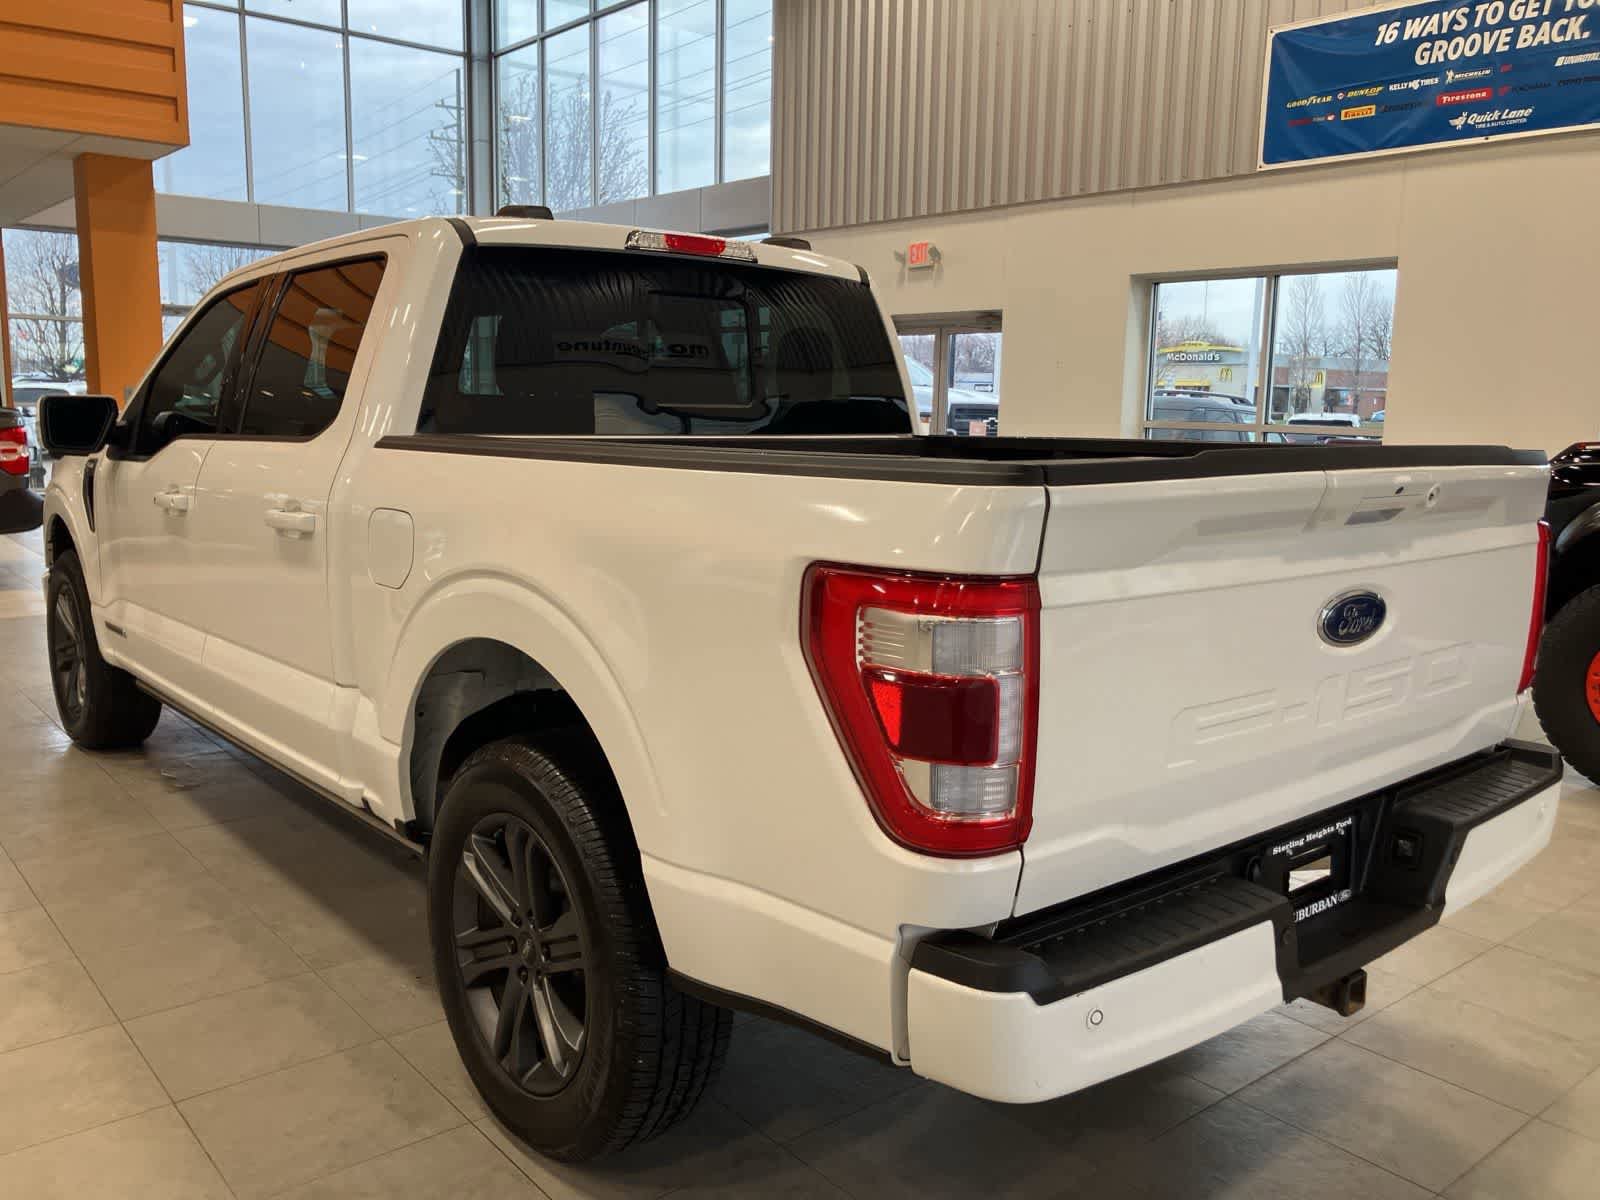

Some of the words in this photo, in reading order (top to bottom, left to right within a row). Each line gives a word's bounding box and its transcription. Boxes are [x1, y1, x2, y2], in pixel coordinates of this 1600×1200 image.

[1375, 22, 1401, 46] 16
[1403, 7, 1470, 41] WAYS
[1474, 1, 1505, 28] TO
[1508, 0, 1552, 21] GET
[1415, 27, 1514, 66] GROOVE
[1516, 14, 1591, 49] BACK.
[1286, 95, 1333, 109] GOODYEAR
[1467, 110, 1501, 125] Quick
[1502, 107, 1534, 119] Lane
[909, 243, 929, 264] EXIT
[1166, 351, 1220, 361] McDonald's
[1338, 603, 1378, 635] Ford
[1272, 839, 1304, 855] Sterling
[1306, 826, 1334, 841] Heights
[1336, 817, 1352, 830] Ford
